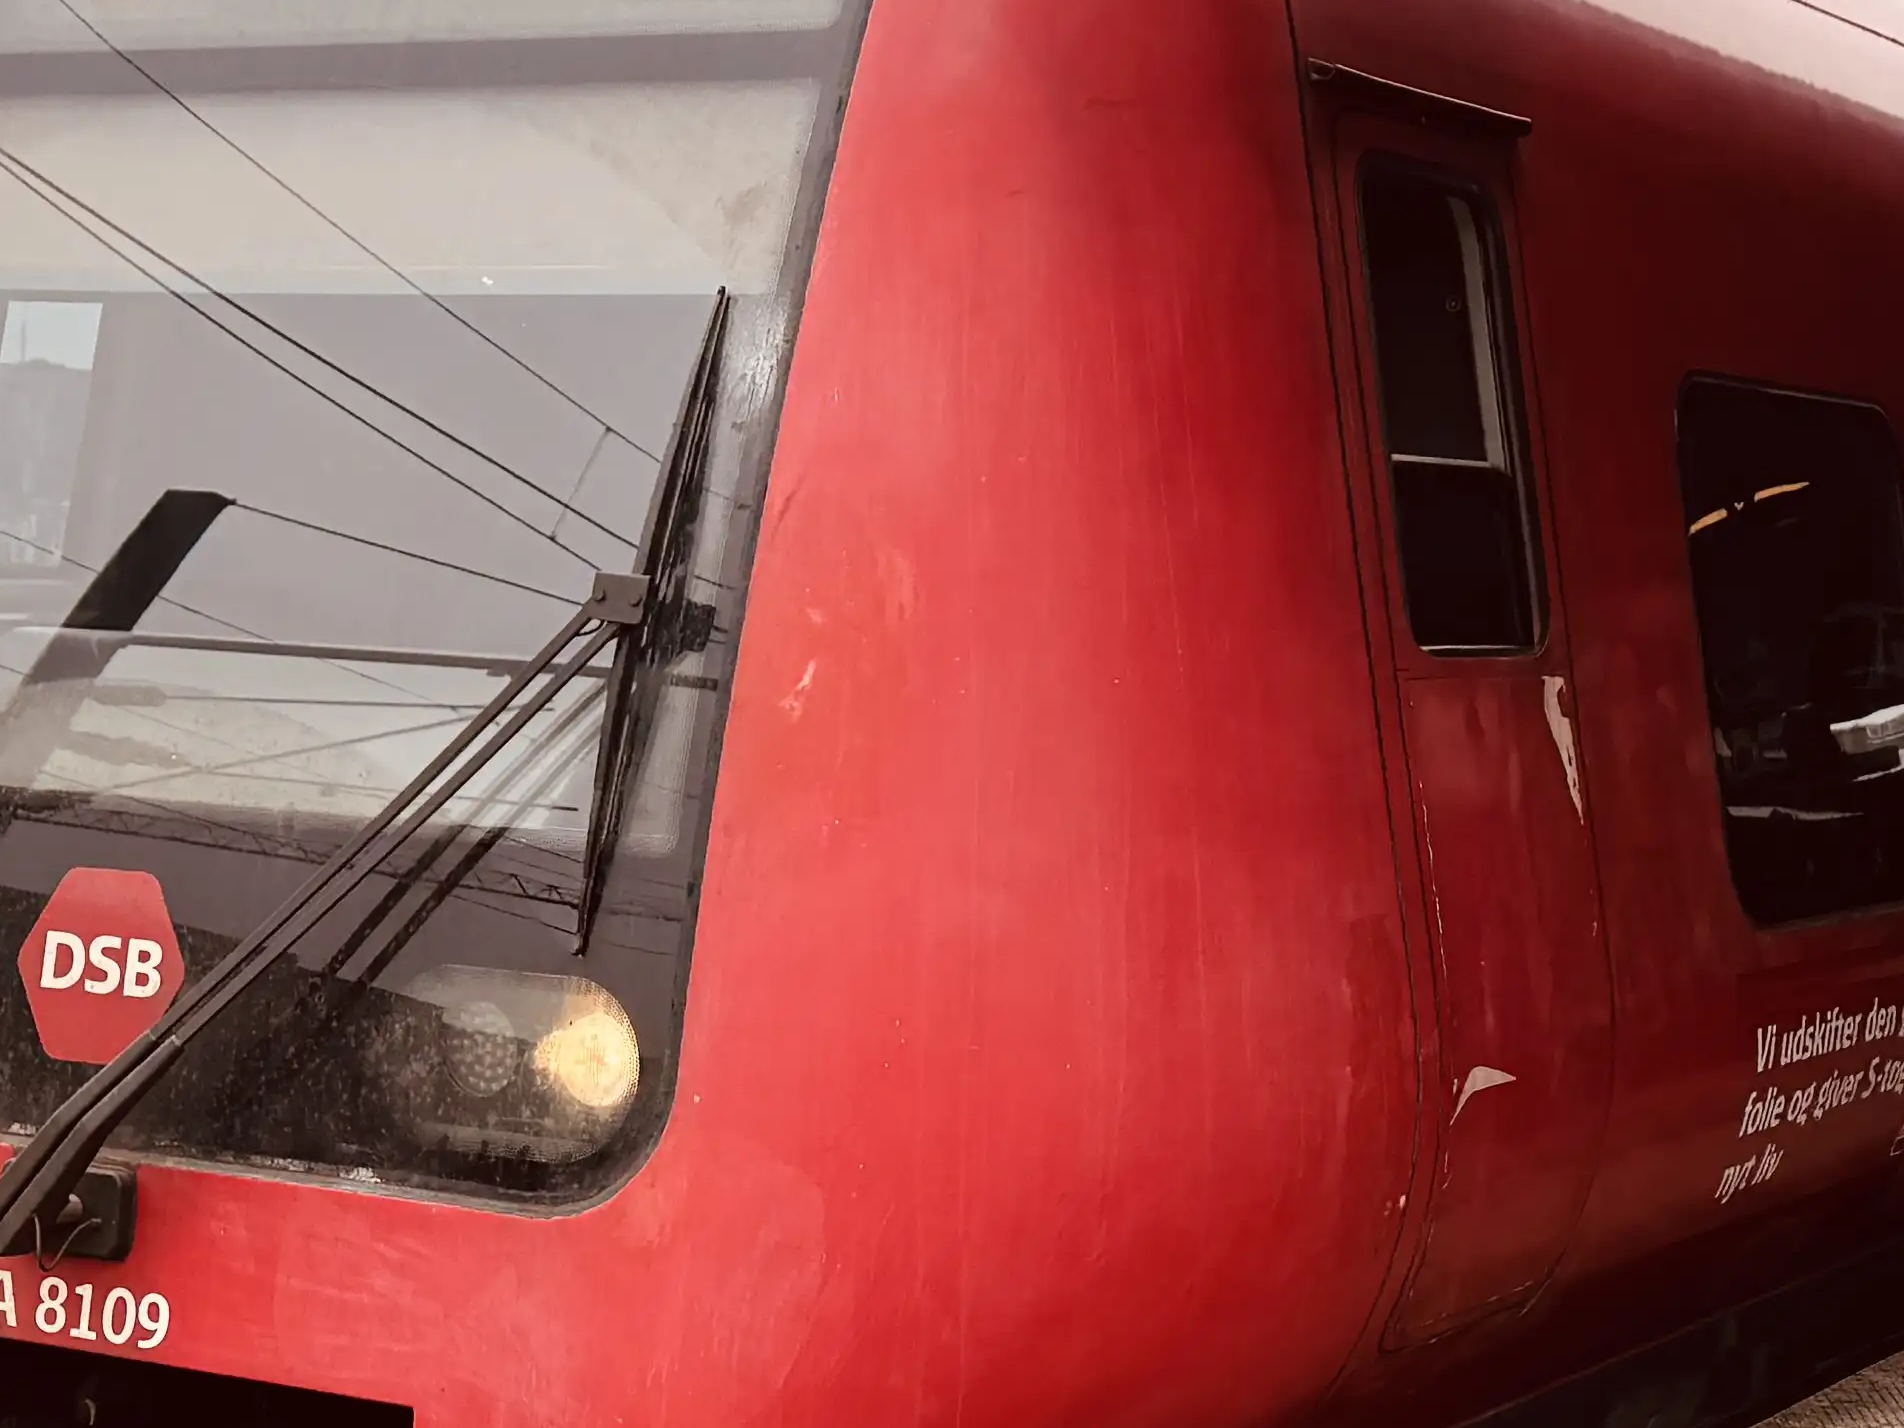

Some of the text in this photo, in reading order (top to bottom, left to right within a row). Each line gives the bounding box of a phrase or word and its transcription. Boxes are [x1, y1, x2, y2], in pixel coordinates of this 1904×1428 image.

[39, 929, 164, 999] DSB
[1756, 1025, 1777, 1072] Vi
[1780, 1006, 1863, 1067] udskifter
[1865, 997, 1897, 1041] den
[1739, 1085, 1786, 1139] folie
[1788, 1080, 1816, 1126] og
[1813, 1068, 1864, 1121] giver
[1714, 1143, 1784, 1204] nyt liv
[34, 1275, 171, 1351] 8109
